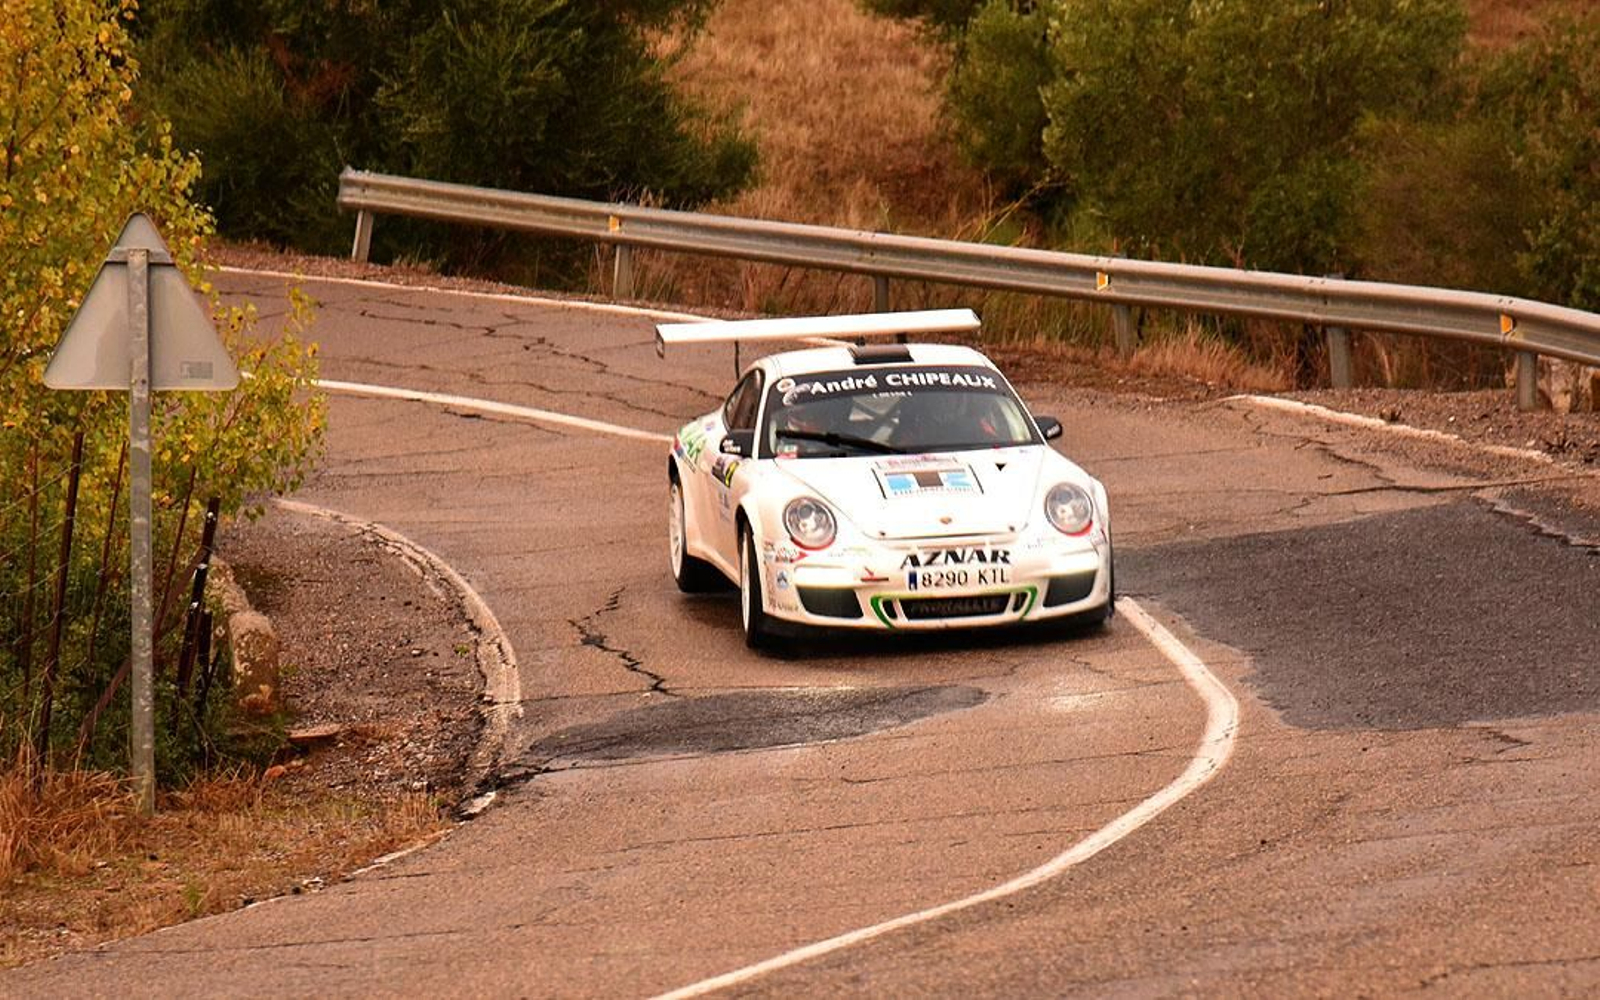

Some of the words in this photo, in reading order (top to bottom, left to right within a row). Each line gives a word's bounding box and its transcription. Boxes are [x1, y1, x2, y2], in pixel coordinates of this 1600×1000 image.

[810, 374, 878, 395] André
[885, 372, 997, 389] CHIPEAUX
[900, 548, 1011, 569] AZNAR
[921, 569, 968, 588] 8290
